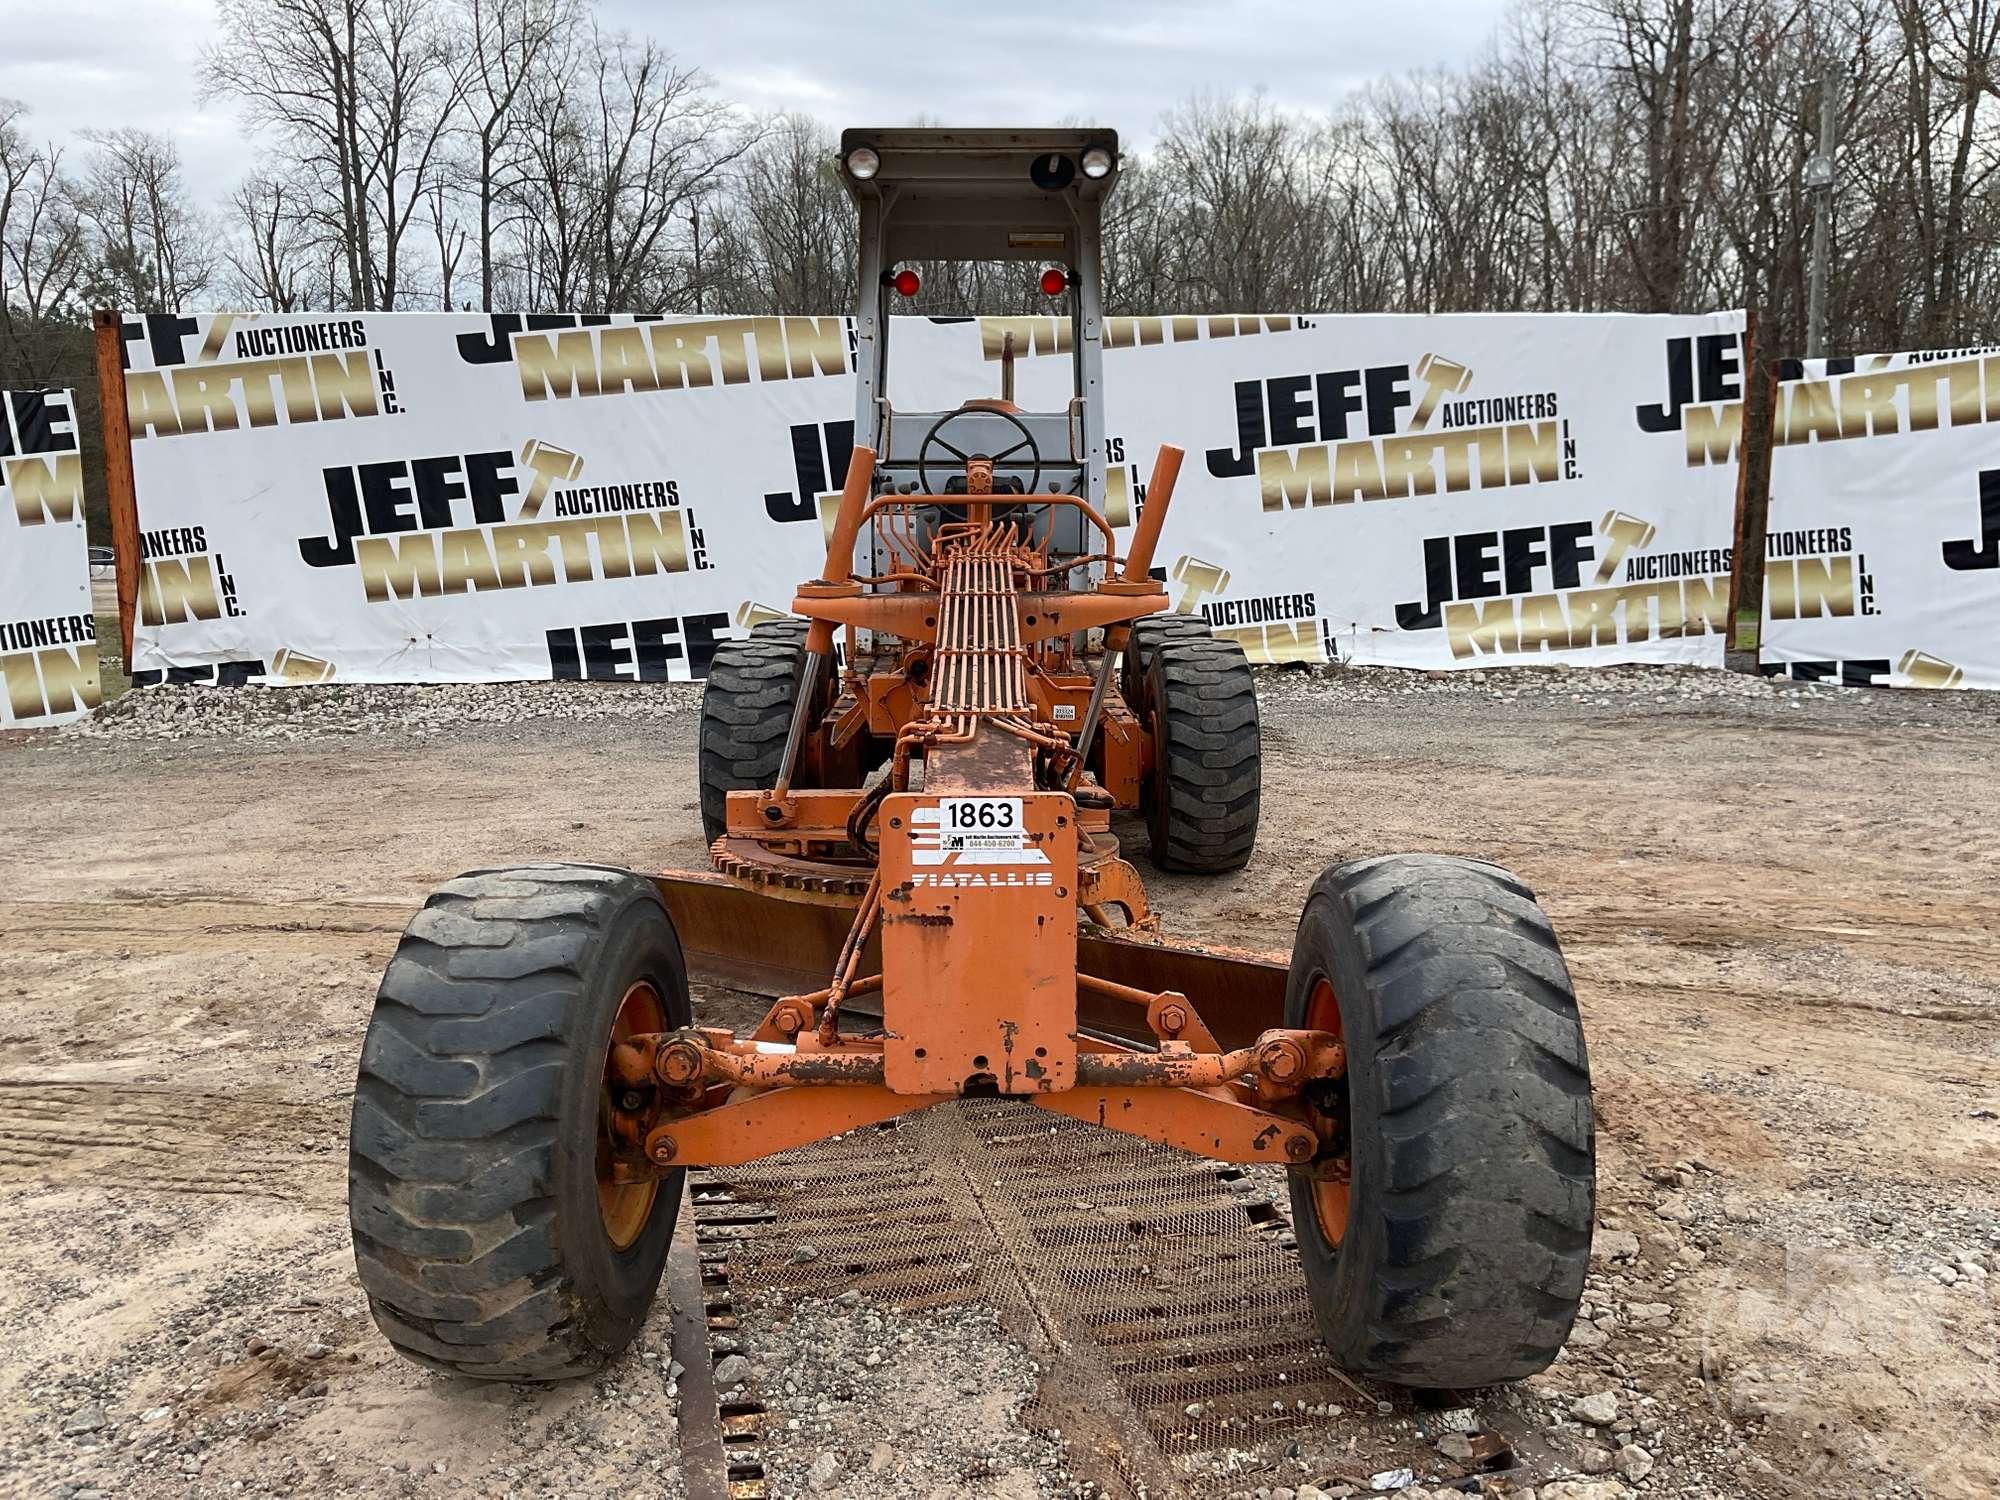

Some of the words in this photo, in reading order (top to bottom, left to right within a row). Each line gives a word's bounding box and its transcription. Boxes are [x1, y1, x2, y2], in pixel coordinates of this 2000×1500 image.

[236, 320, 366, 359] AUCTIONEERS
[515, 316, 846, 402] MARTIN
[1206, 365, 1411, 479] JEFF
[1442, 393, 1557, 429] AUCTIONEERS
[554, 480, 680, 517] AUCTIONEERS
[1258, 421, 1559, 513] MARTIN
[298, 451, 520, 568] JEFF
[356, 510, 690, 603] MARTIN
[1395, 521, 1595, 631] JEFF
[1626, 549, 1732, 582] AUCTIONEERS
[1202, 593, 1316, 629] AUCTIONEERS
[1445, 576, 1731, 660] MARTIN
[948, 802, 1014, 829] 1863
